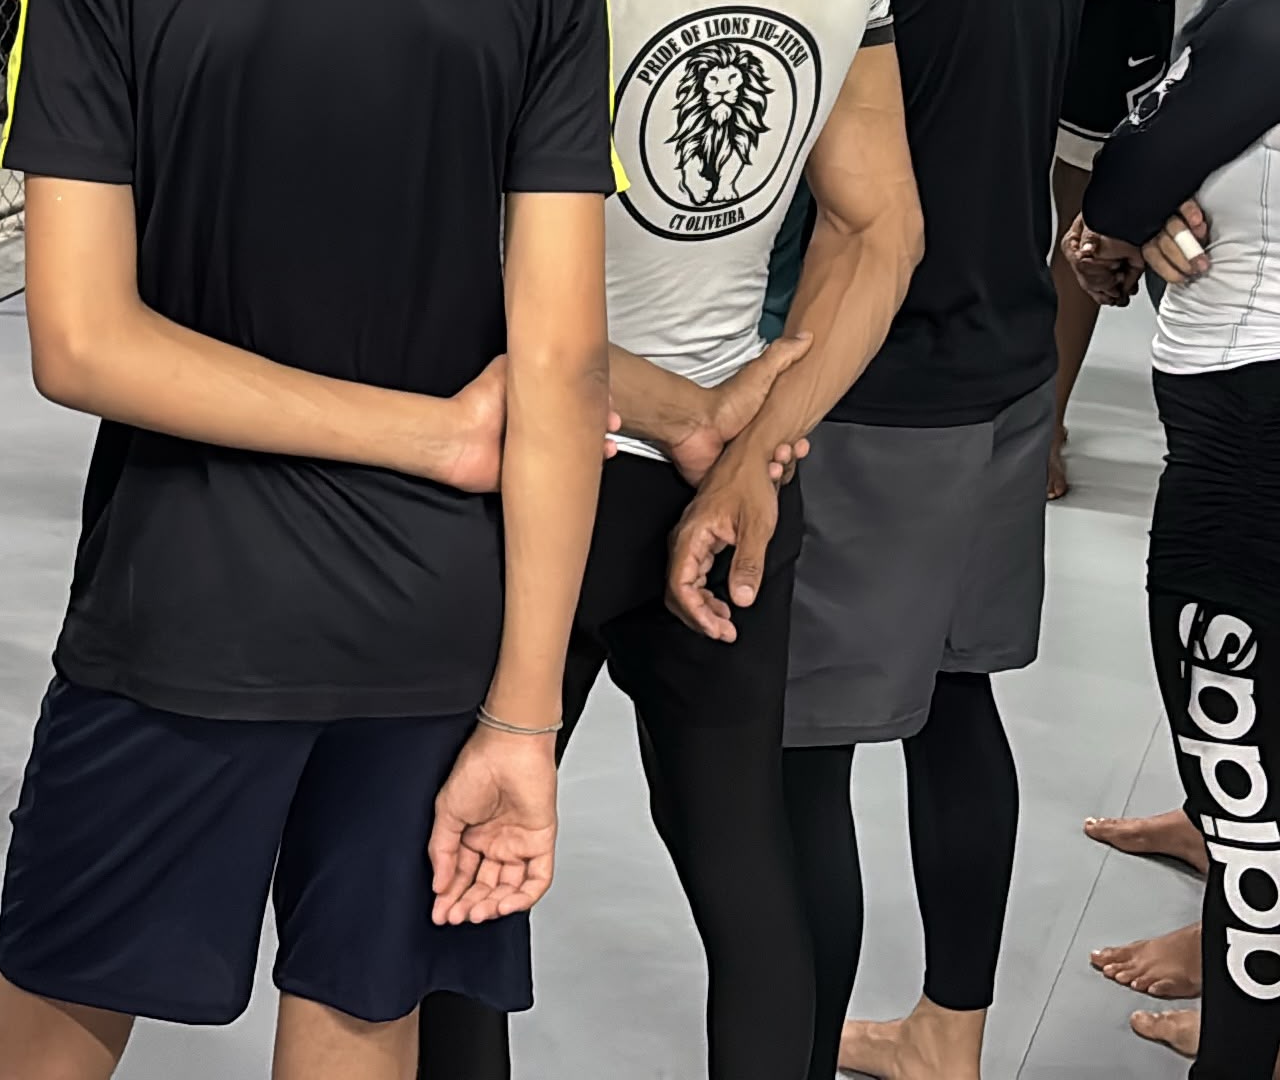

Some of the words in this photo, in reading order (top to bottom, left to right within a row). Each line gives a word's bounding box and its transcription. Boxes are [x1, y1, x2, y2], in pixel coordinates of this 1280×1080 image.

[636, 37, 682, 86] PRIDE
[680, 24, 702, 47] OF
[704, 16, 751, 39] LIONS
[750, 18, 809, 69] JIU-JITSU
[669, 213, 687, 231] CT
[685, 206, 745, 232] OLIVEIRA
